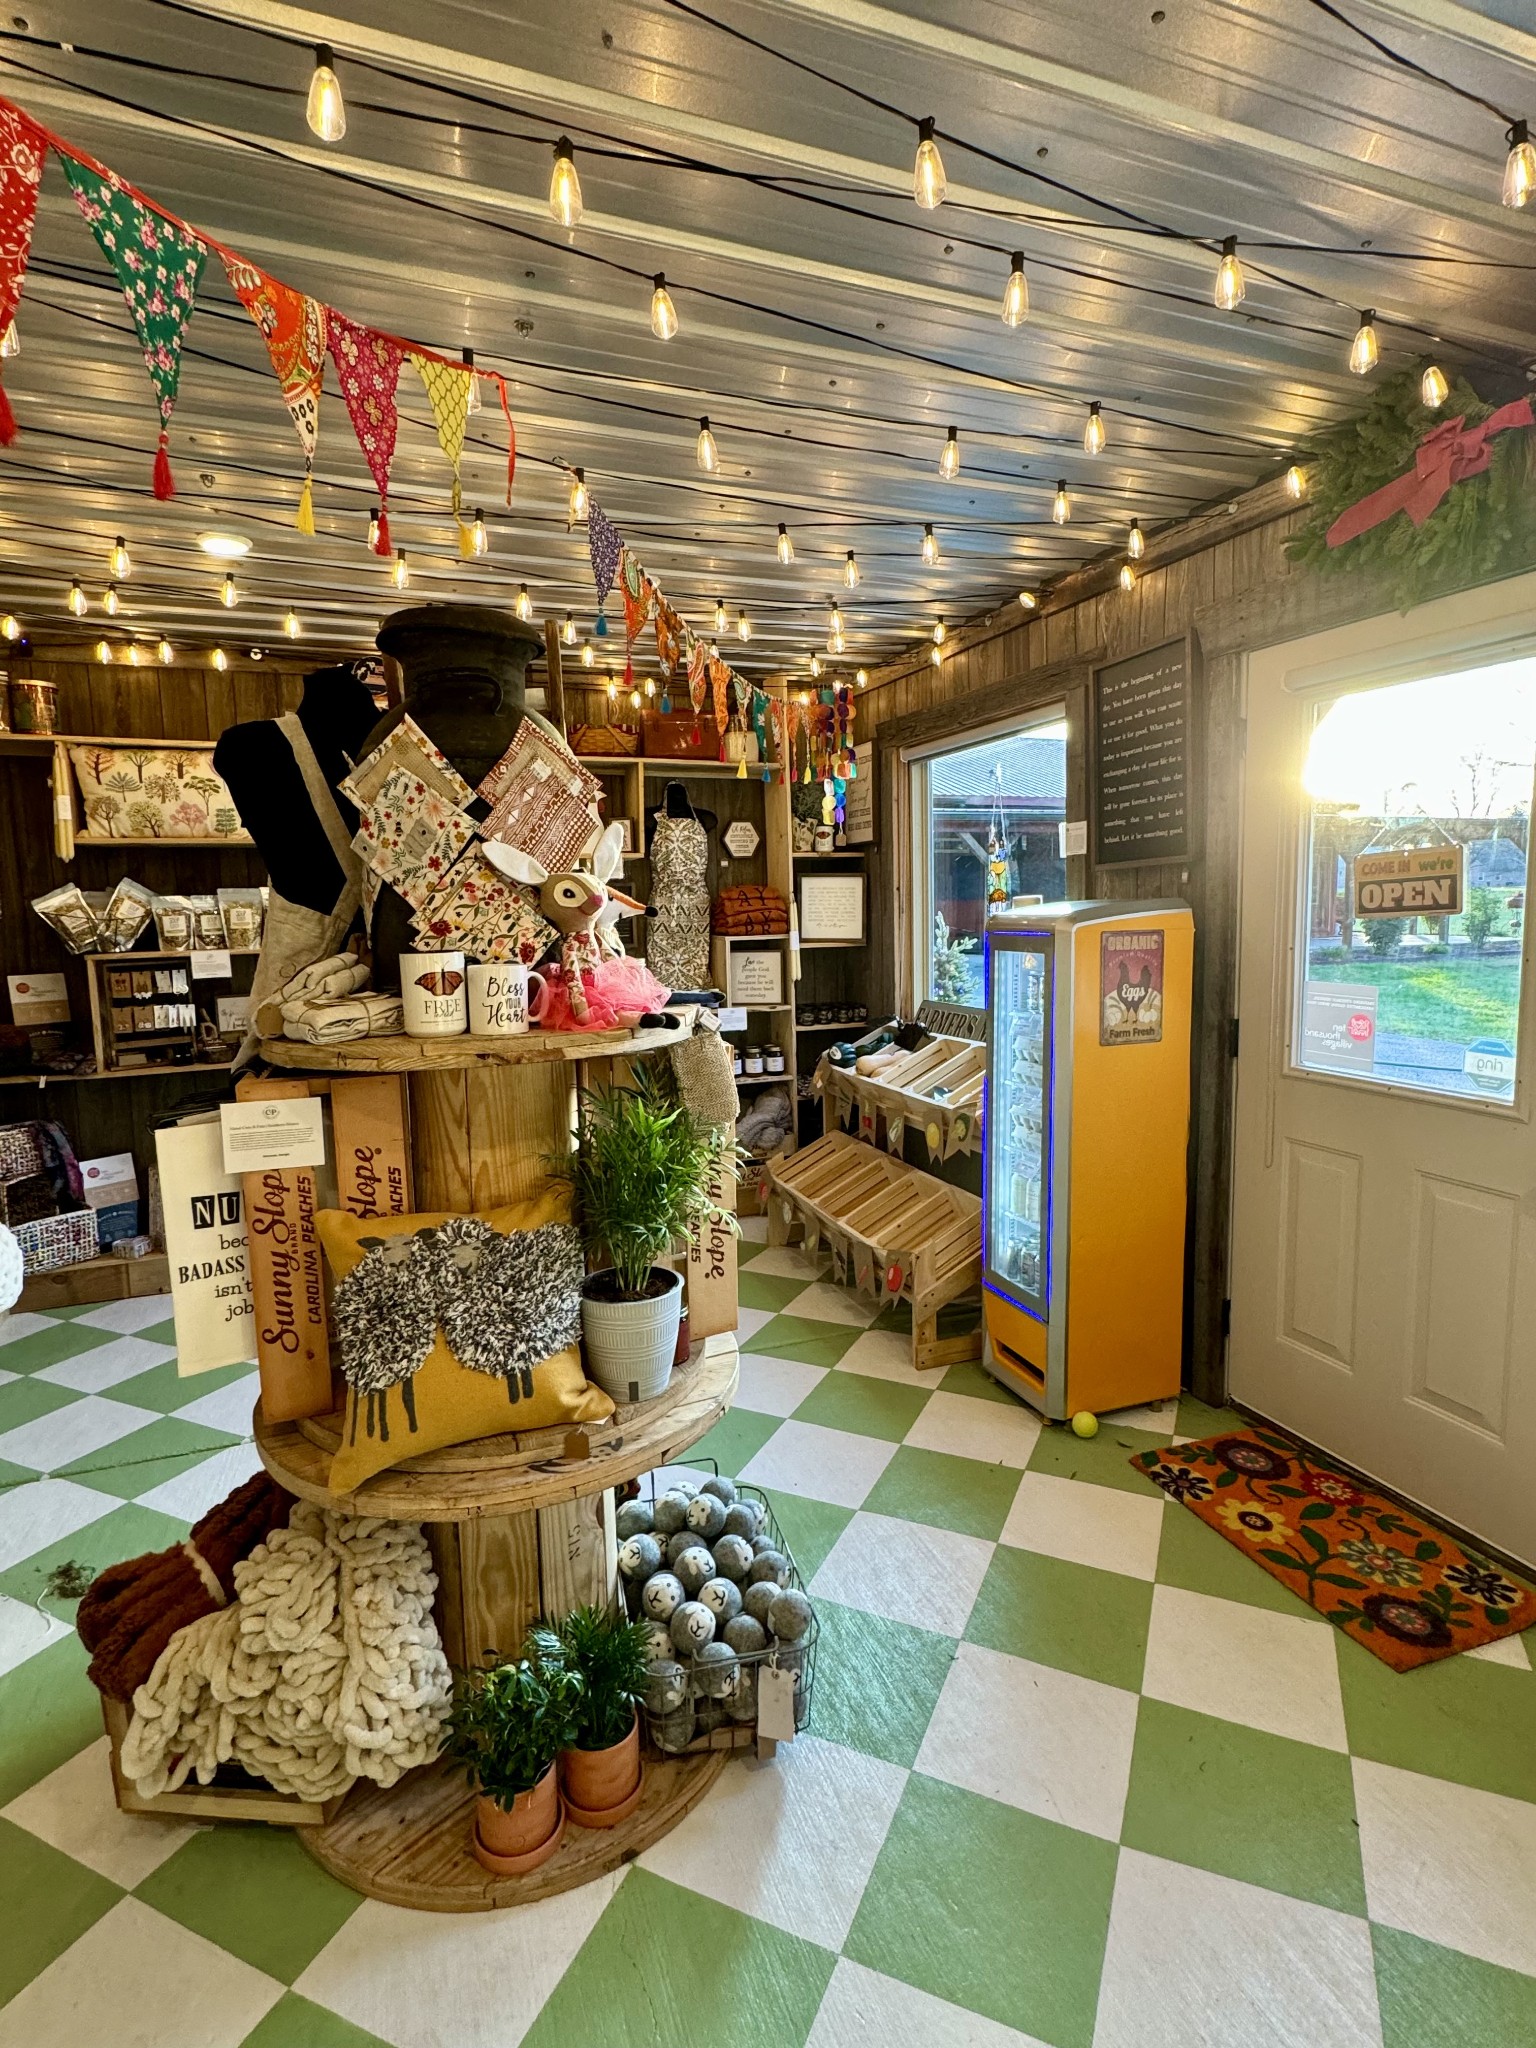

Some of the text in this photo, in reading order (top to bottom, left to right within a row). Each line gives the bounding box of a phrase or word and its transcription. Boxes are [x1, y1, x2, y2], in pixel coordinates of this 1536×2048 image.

[1131, 673, 1154, 685] beginning
[1156, 668, 1162, 676] of
[1148, 689, 1160, 698] given
[1165, 722, 1174, 730] you
[1103, 754, 1114, 762] today
[1121, 747, 1142, 757] important
[1144, 743, 1162, 751] because
[1103, 768, 1127, 778] exchanging
[1119, 783, 1140, 791] tomorrow
[1164, 792, 1177, 802] place
[1104, 819, 1126, 827] something
[1175, 808, 1183, 816] left
[1144, 830, 1168, 838] something
[1362, 856, 1453, 875] COME IN we're
[1361, 879, 1451, 908] OPEN
[1108, 935, 1159, 951] ORGANIC
[486, 976, 525, 998] Bless
[1122, 984, 1145, 1001] Eggs
[424, 998, 462, 1014] FREE
[505, 998, 521, 1009] YOUR
[482, 1002, 525, 1027] Heart
[1109, 1027, 1155, 1038] Farm Fresh
[388, 1166, 404, 1216] ACHES
[192, 1194, 240, 1227] NU
[252, 1168, 290, 1244] Slop
[290, 1223, 298, 1254] BRAND
[296, 1175, 322, 1324] CAROLINA PEACHES
[178, 1256, 245, 1284] BADASS
[215, 1276, 254, 1298] isn't
[262, 1249, 300, 1354] Sunny
[224, 1302, 254, 1322] job
